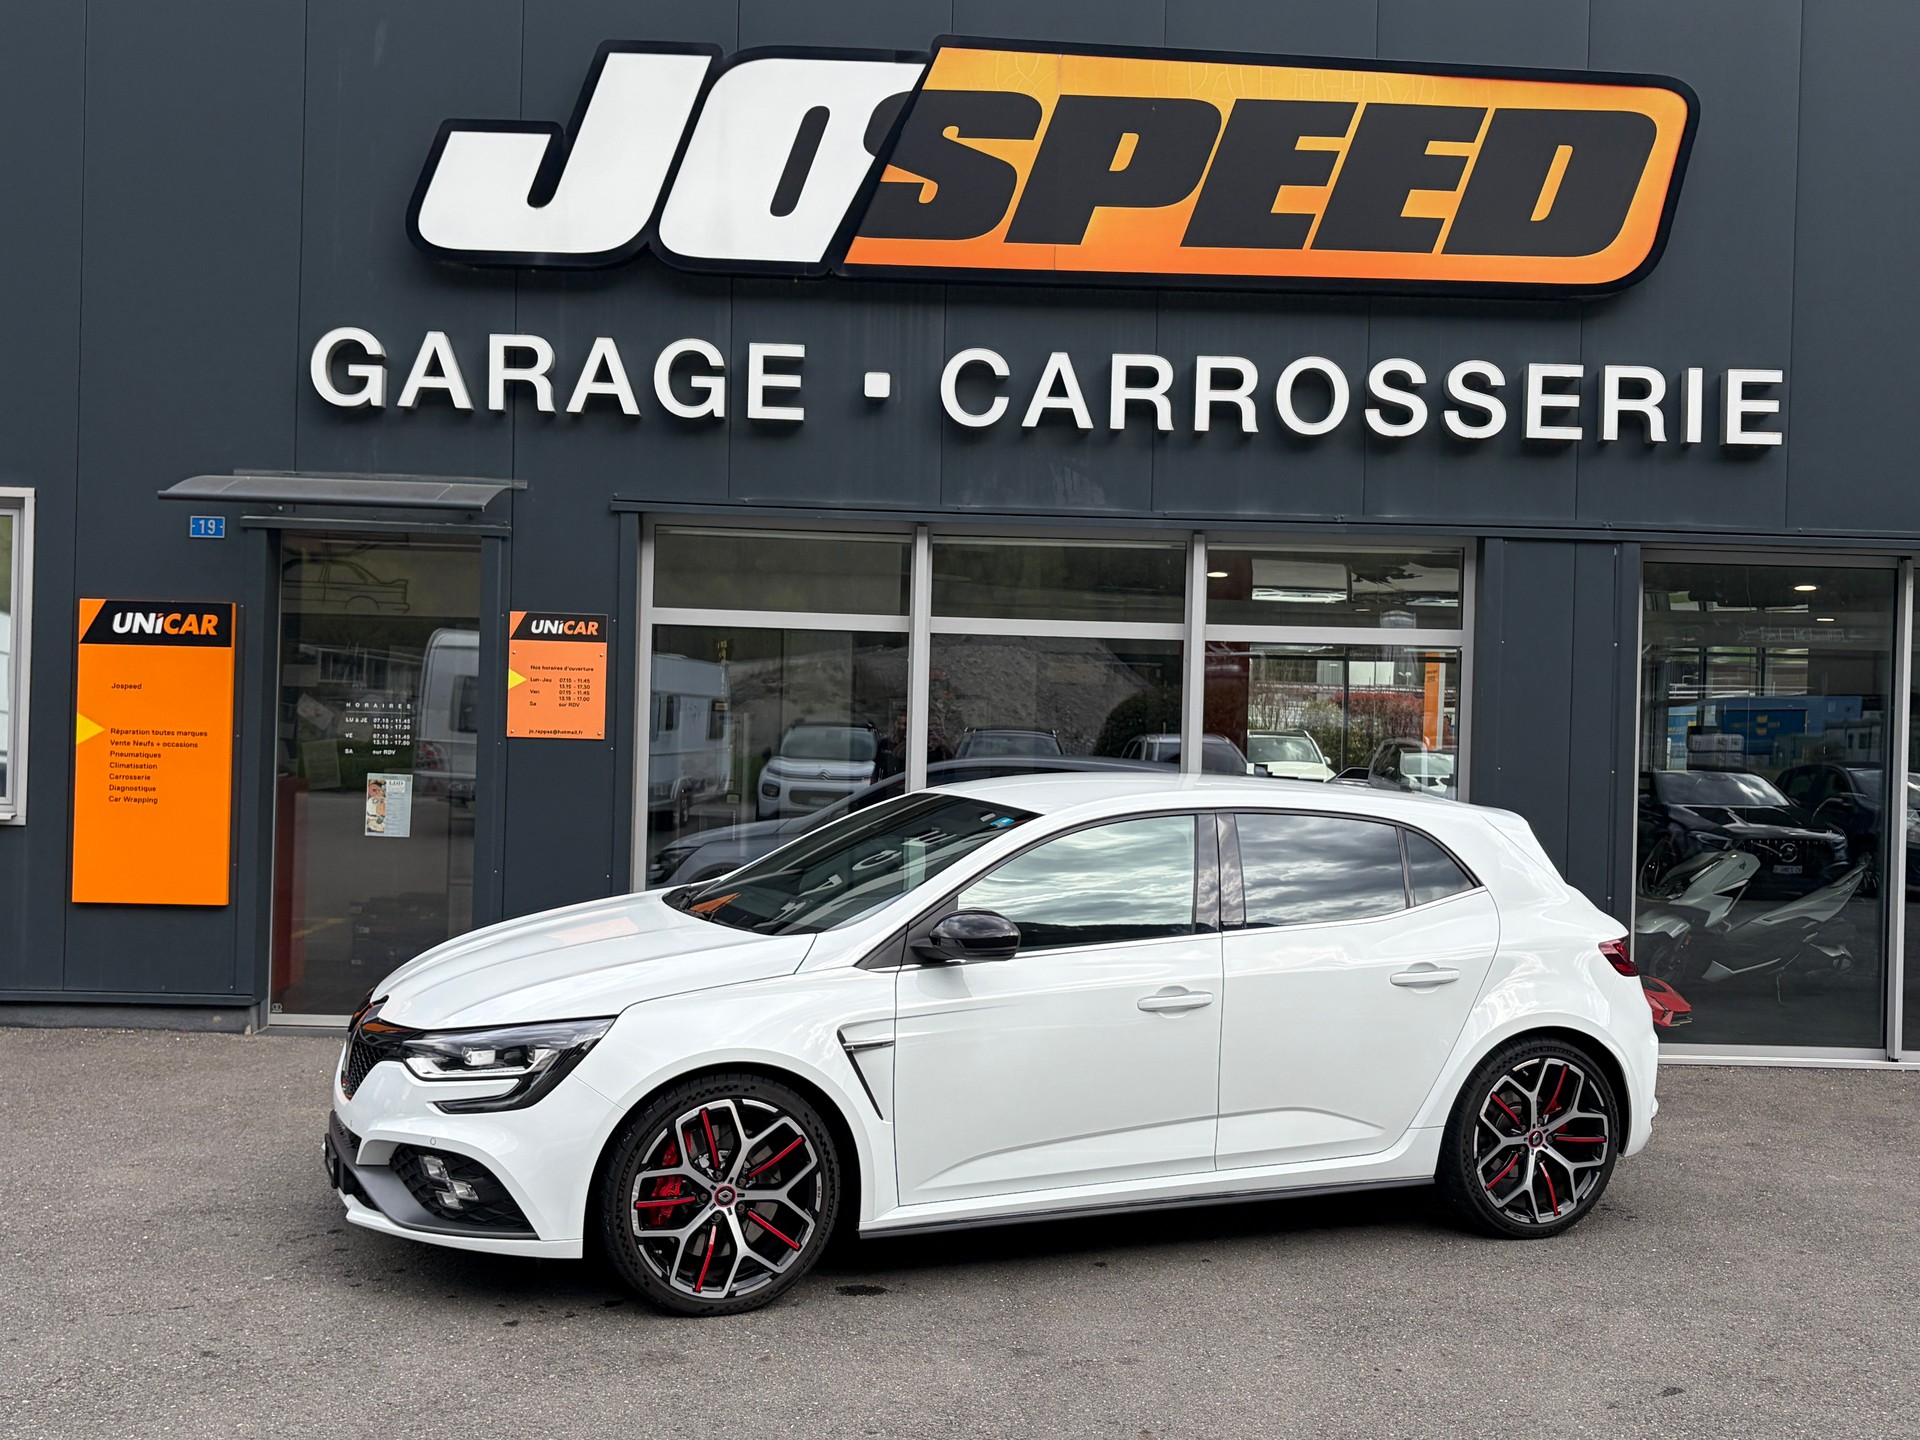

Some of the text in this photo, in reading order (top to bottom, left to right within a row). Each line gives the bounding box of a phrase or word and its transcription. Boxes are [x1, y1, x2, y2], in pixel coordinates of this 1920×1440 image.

[310, 326, 1784, 447] GARAGE CARROSSERIE
[199, 519, 216, 535] 19
[111, 682, 143, 691] Jospeed
[110, 727, 208, 738] Réparation toutes marques
[110, 739, 131, 747] Vente
[132, 739, 155, 747] Neufs
[109, 750, 162, 760] Pneumatiques
[109, 762, 158, 770] Climatisation
[109, 773, 151, 781] Carrosserie
[109, 784, 157, 794] Diagnostique
[108, 795, 159, 805] Car Wrapping
